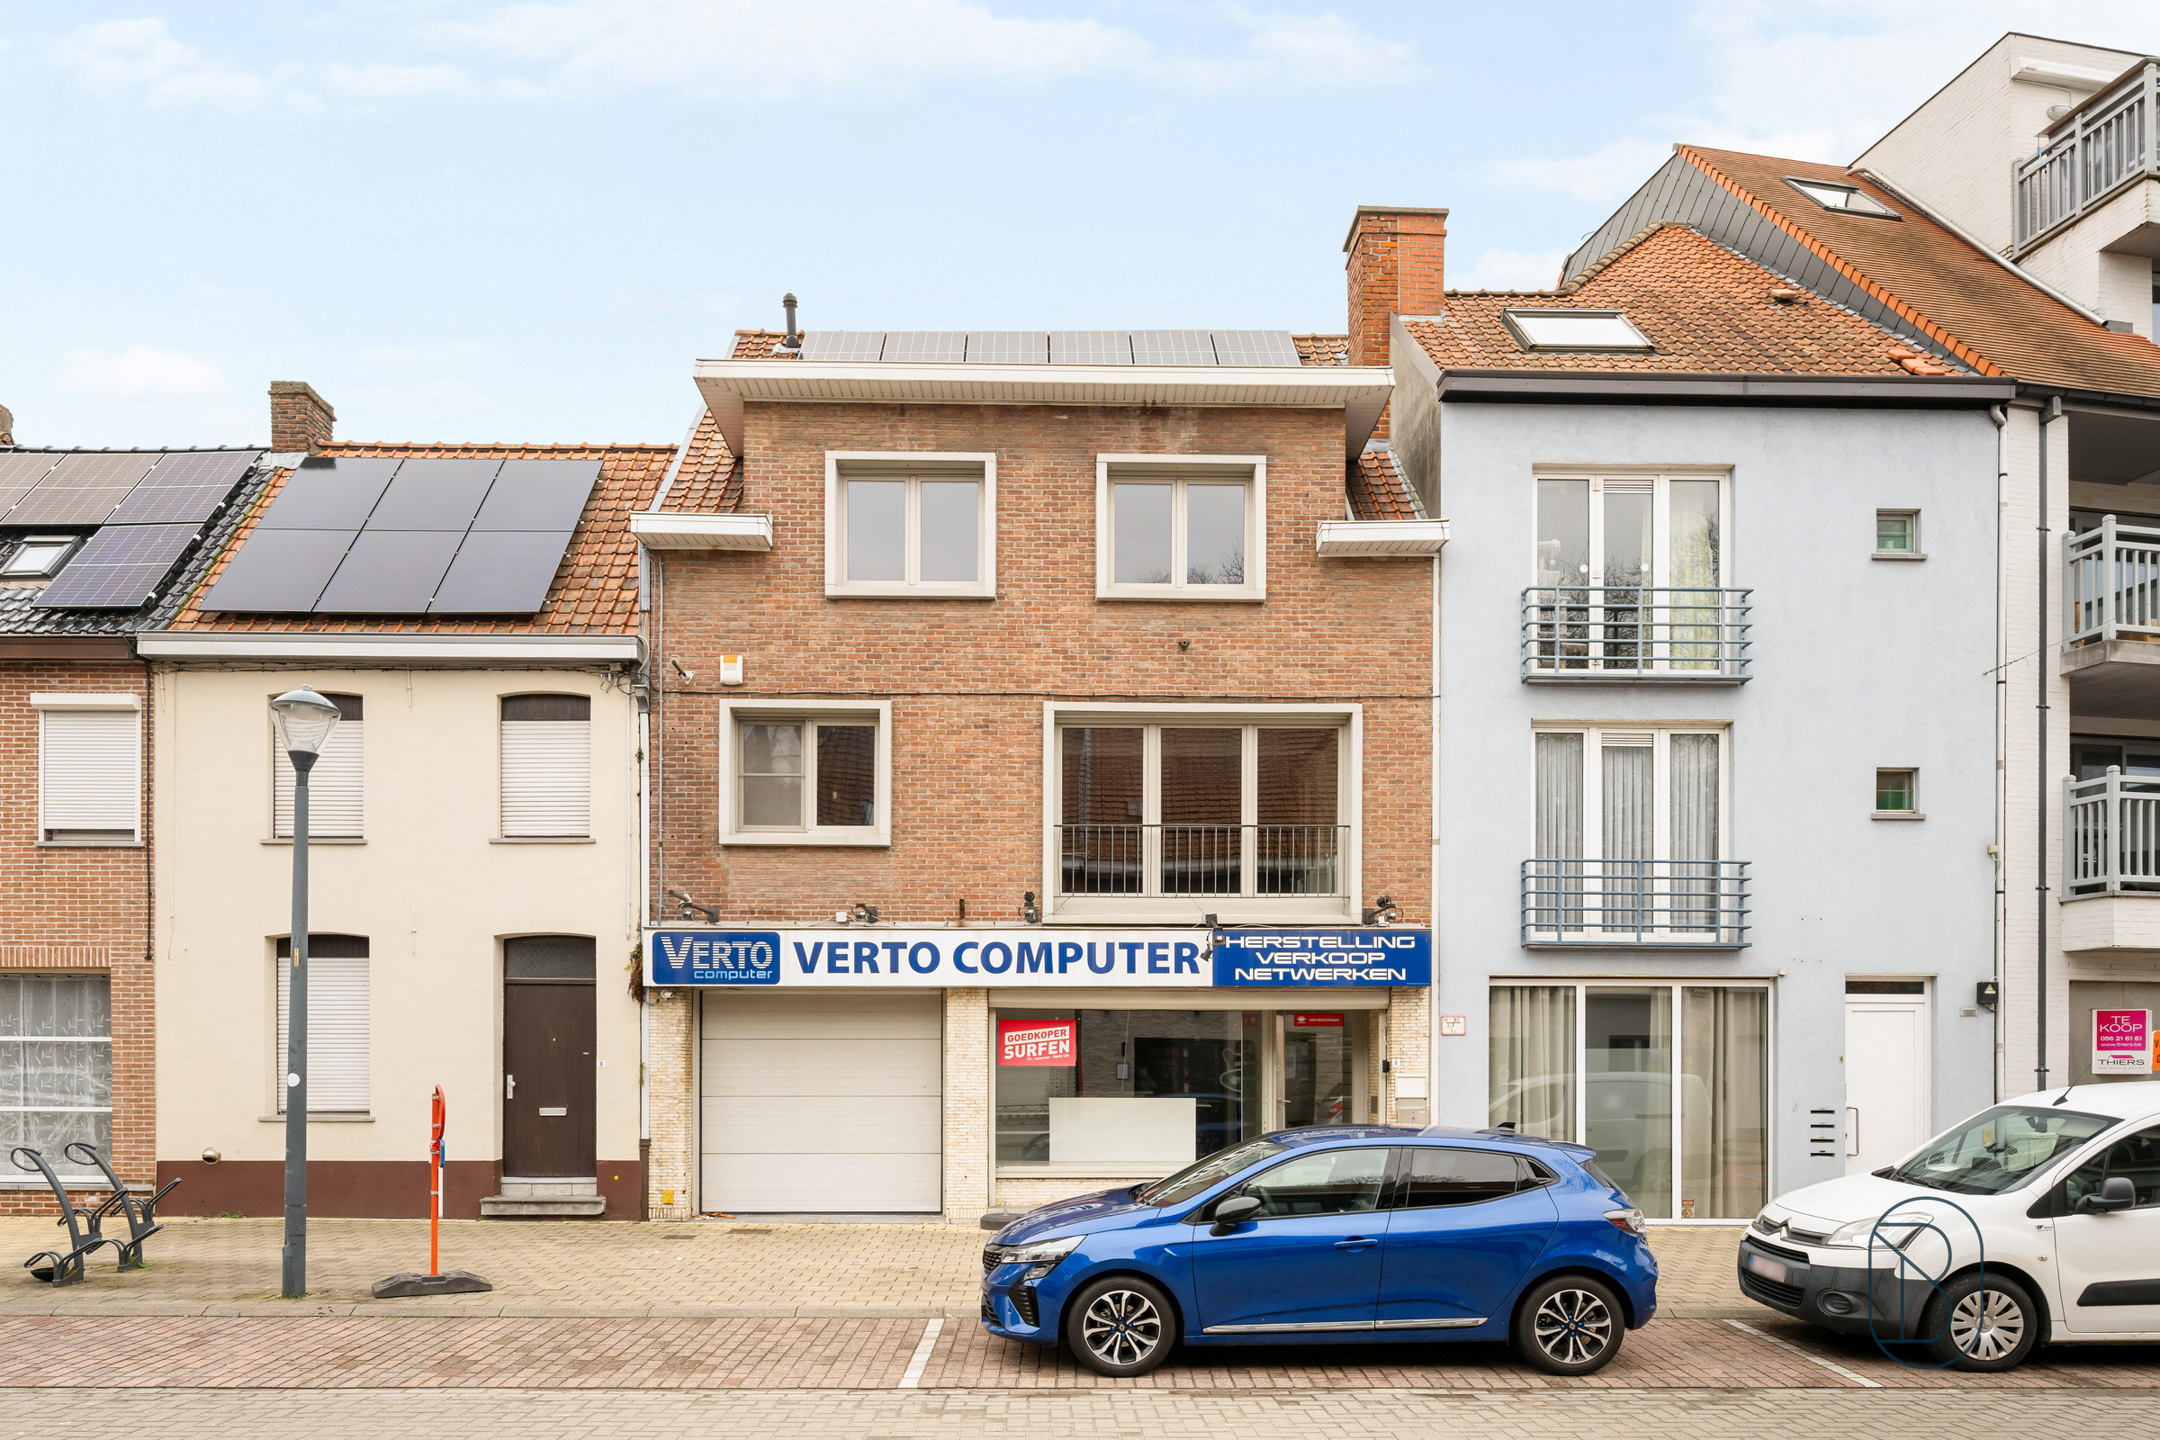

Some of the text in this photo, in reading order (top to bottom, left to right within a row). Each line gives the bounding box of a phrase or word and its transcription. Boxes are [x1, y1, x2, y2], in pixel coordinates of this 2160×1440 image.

[1225, 936, 1415, 949] HERSTELLING
[660, 936, 773, 969] VERTO
[793, 941, 1200, 974] VERTO COMPUTER
[1255, 951, 1385, 965] VERKOOP
[693, 969, 773, 981] computer
[1235, 967, 1406, 981] NETWERKEN
[2111, 1015, 2131, 1024] TE
[2100, 1024, 2142, 1033] KOOP
[1007, 1029, 1067, 1042] GOEDKOPER
[1004, 1040, 1070, 1060] SURFEN
